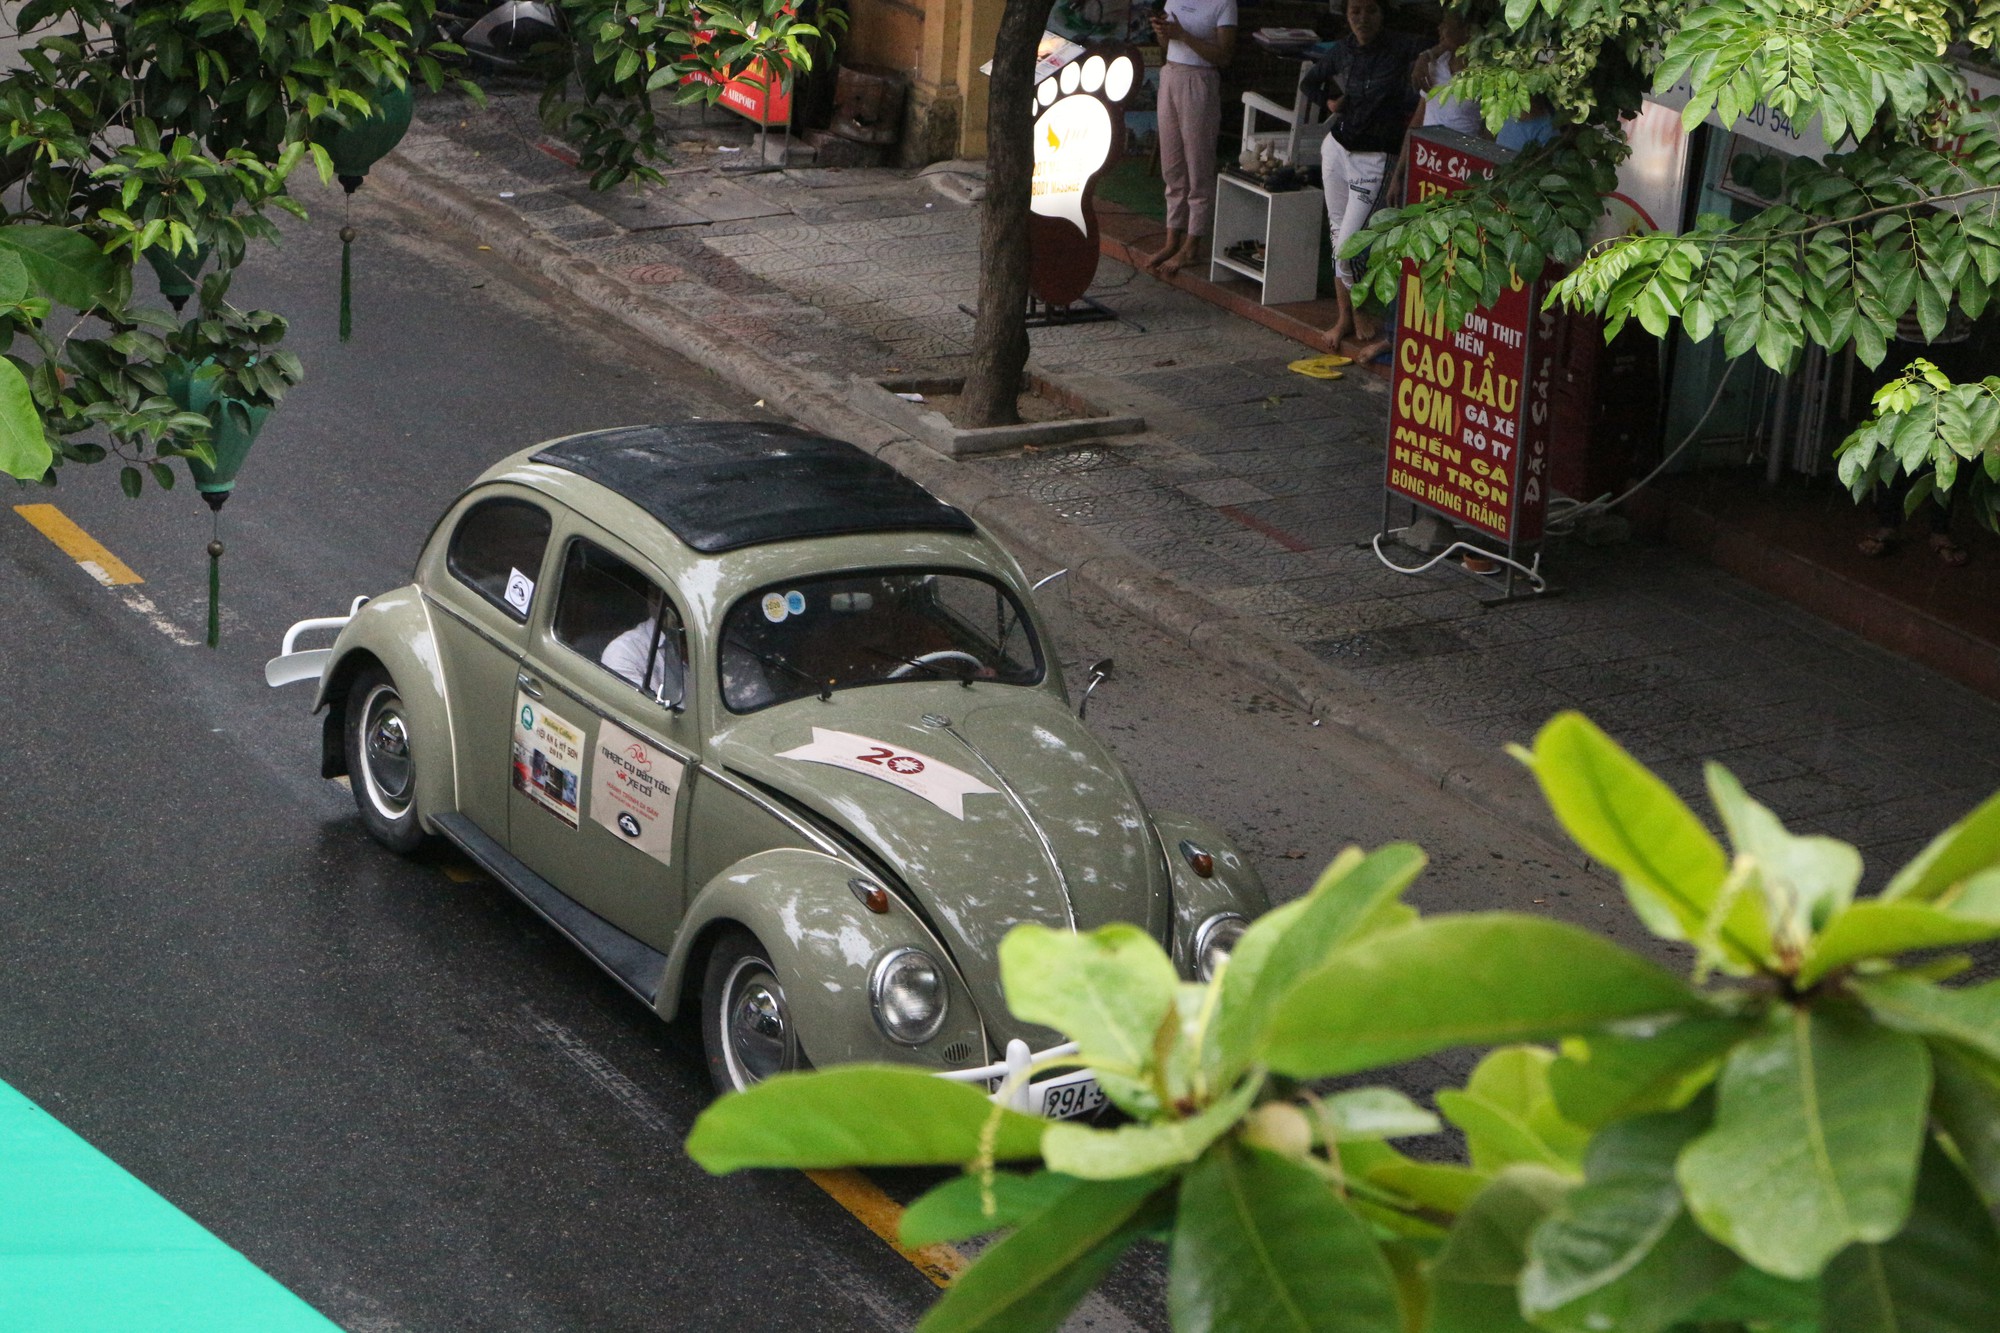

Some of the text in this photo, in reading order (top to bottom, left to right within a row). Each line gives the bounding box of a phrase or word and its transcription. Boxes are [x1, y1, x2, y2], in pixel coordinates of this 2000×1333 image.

[728, 88, 756, 110] AIRPORT
[1416, 143, 1442, 174] Đặc
[1455, 331, 1484, 357] HẾN
[1492, 322, 1522, 349] THỊT
[1401, 338, 1518, 413] CAO LẦU
[1398, 378, 1452, 436] CƠM
[1465, 404, 1515, 438] GÀ XÉ
[1395, 426, 1509, 486] MIẾN GÀ
[1463, 428, 1511, 461] RÔ TY
[1395, 445, 1508, 506] HẾN TRỘN
[1392, 468, 1425, 496] BÔNG
[1466, 500, 1506, 533] TRẮNG
